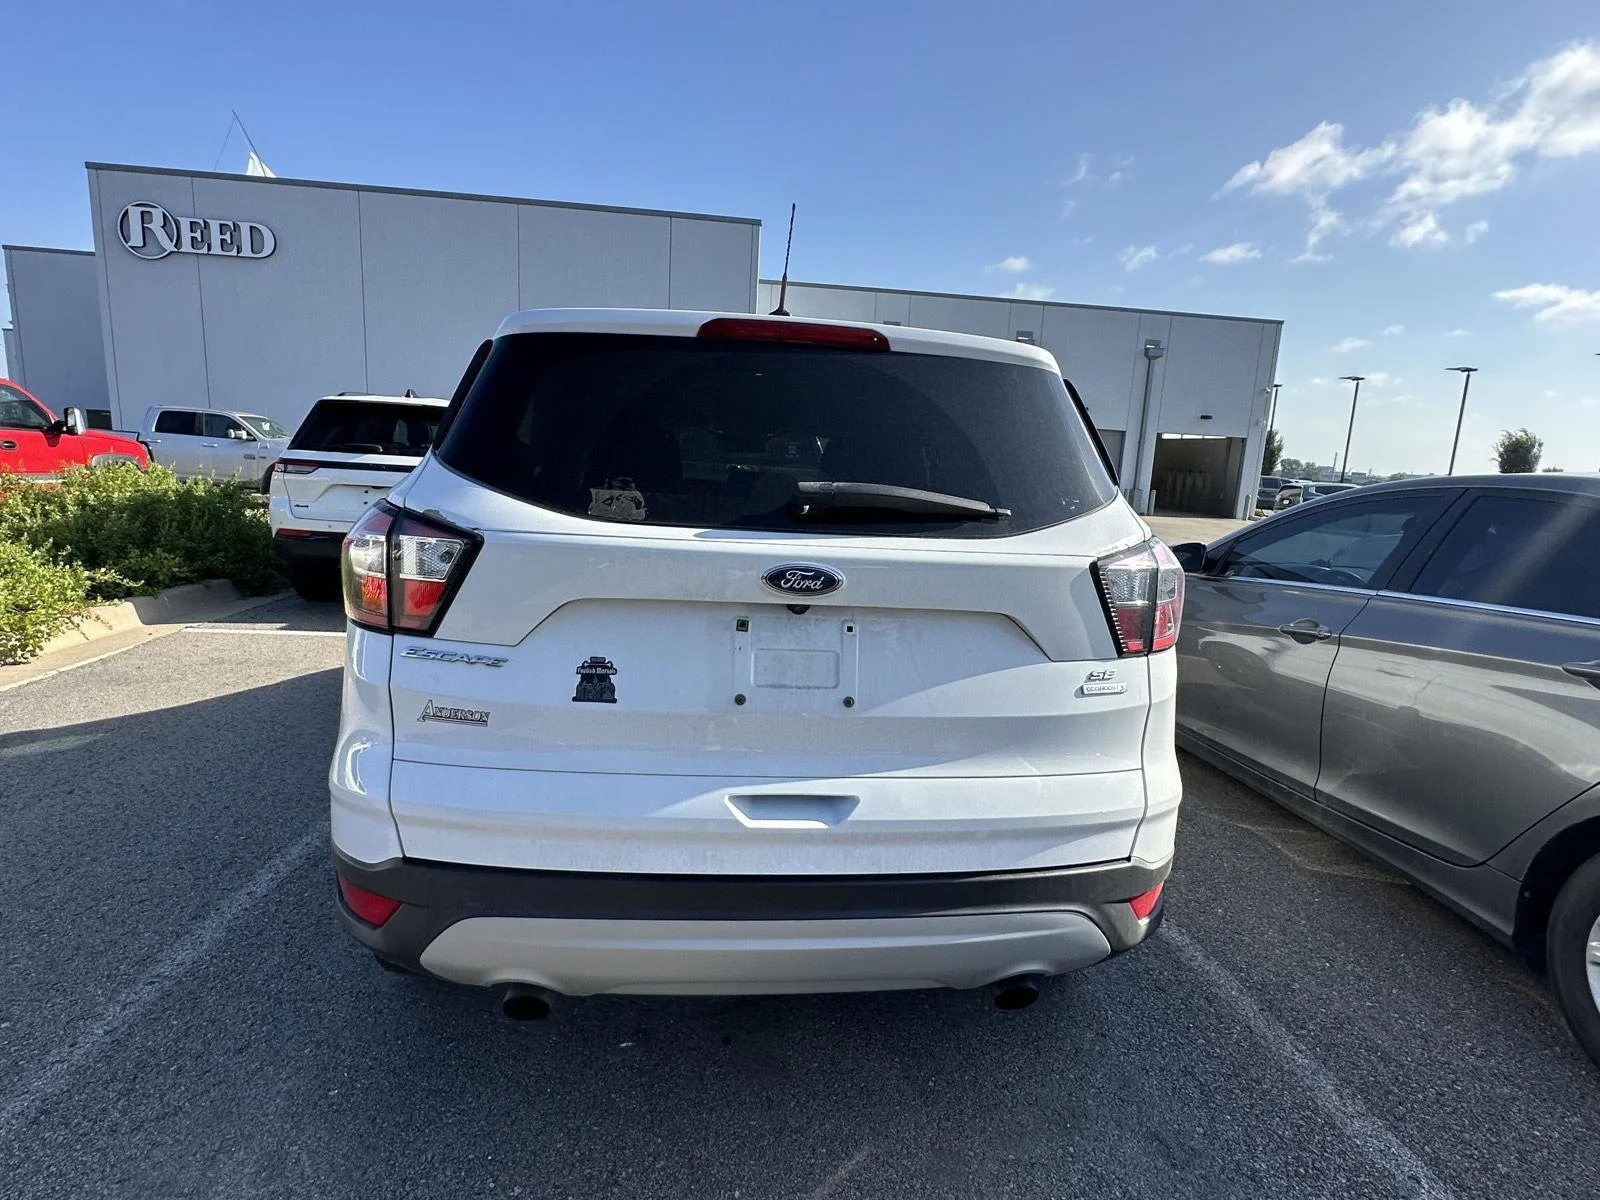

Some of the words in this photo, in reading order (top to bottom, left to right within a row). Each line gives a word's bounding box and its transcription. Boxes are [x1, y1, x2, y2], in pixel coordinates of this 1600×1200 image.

[117, 200, 277, 260] REED
[780, 569, 824, 590] Ford
[399, 645, 508, 667] ESCAPE
[1087, 669, 1118, 682] SE
[417, 699, 490, 727] ANDERSON
